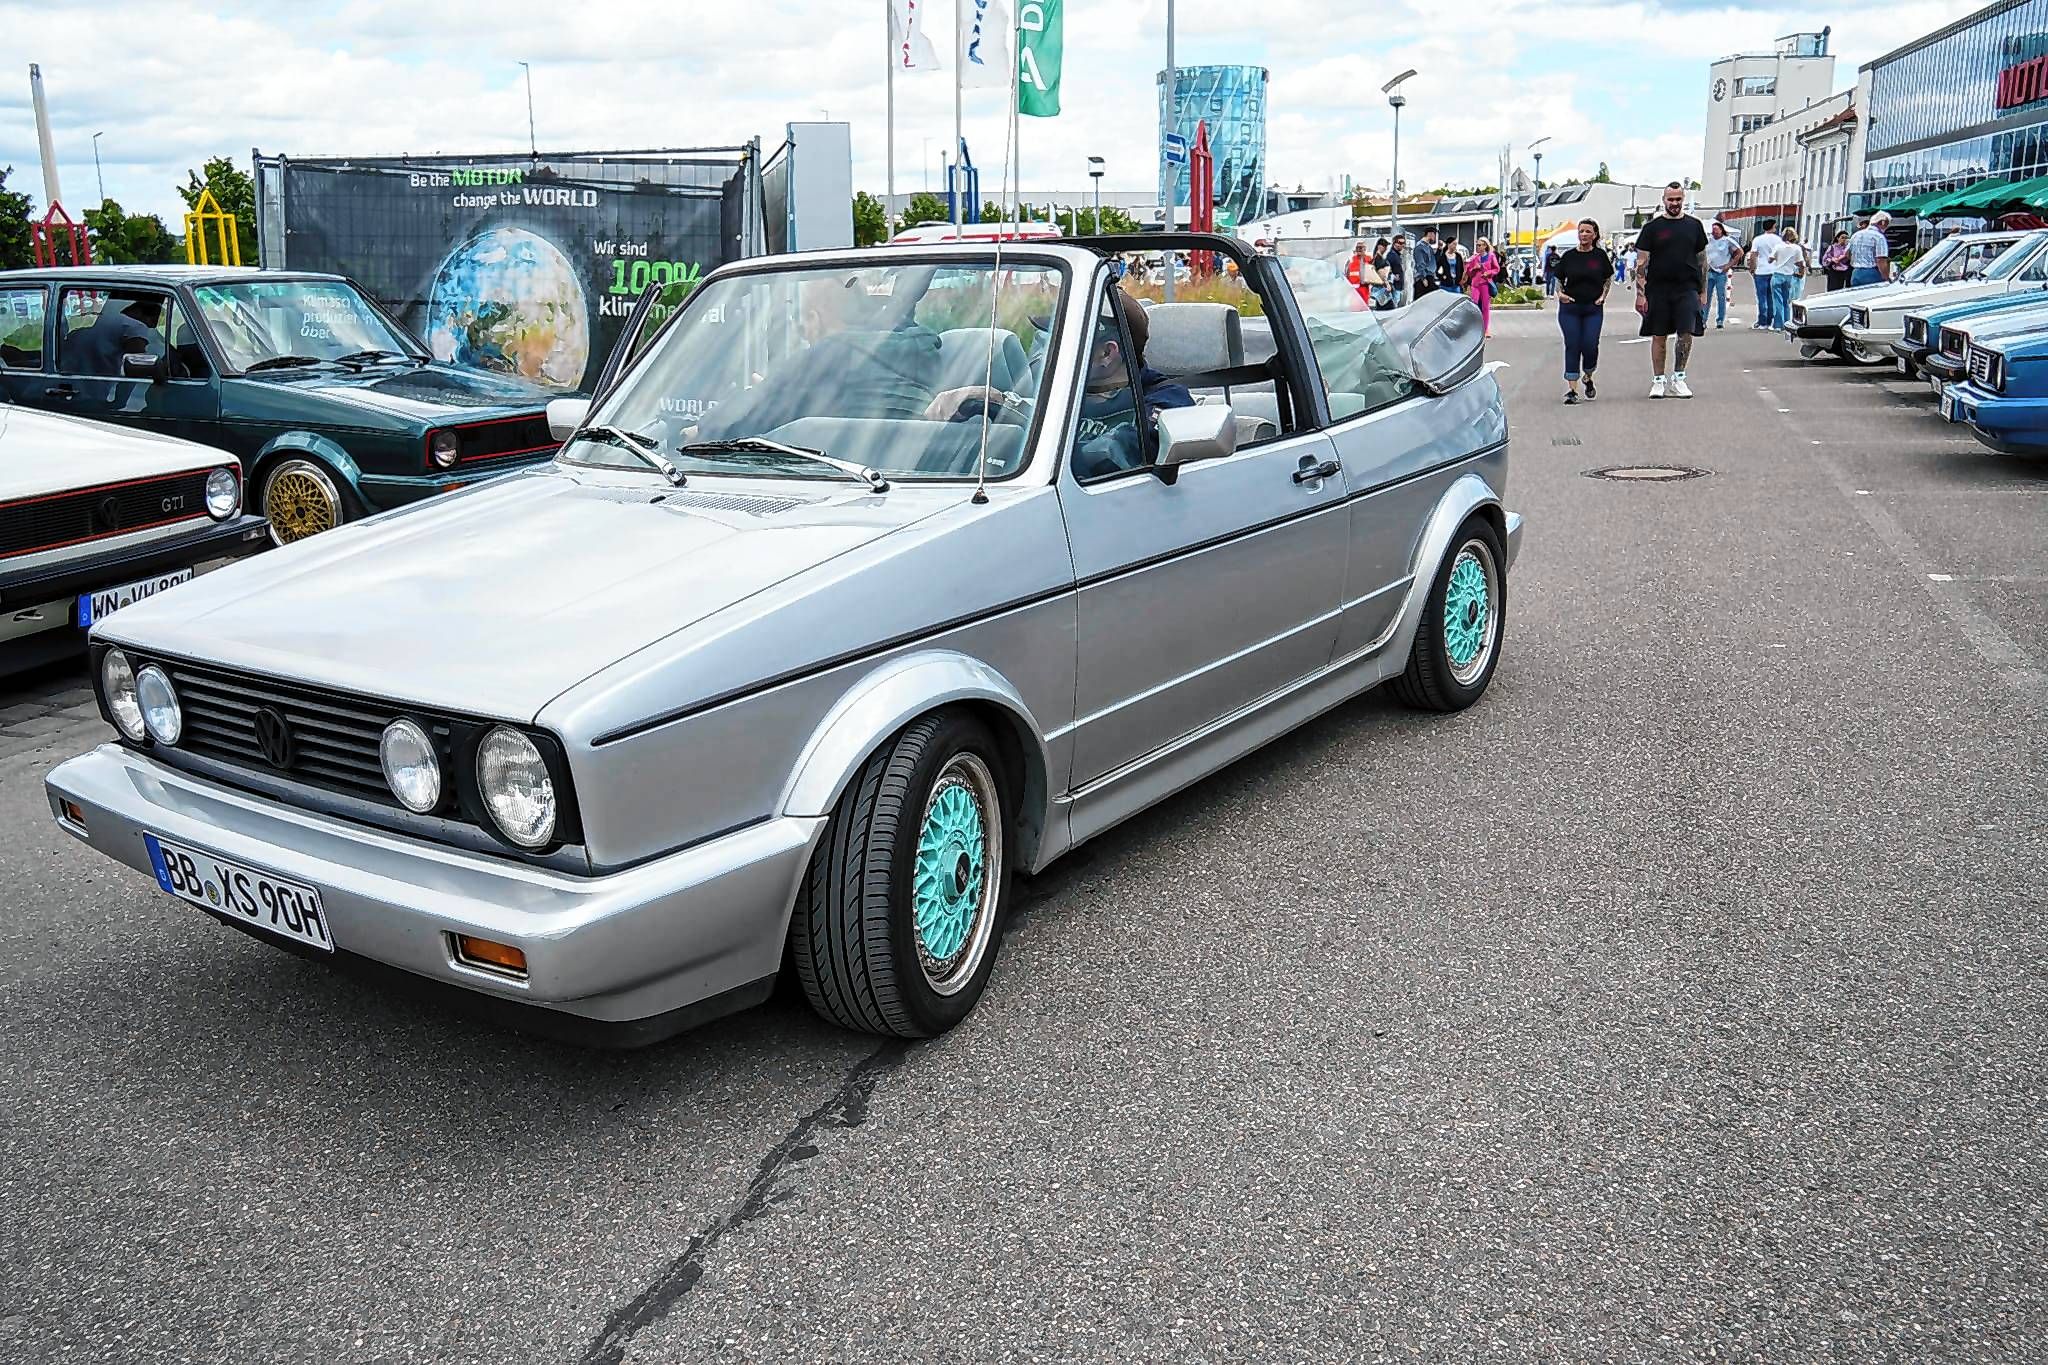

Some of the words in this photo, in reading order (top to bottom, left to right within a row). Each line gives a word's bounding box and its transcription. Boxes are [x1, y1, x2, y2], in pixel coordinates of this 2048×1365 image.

[410, 173, 427, 187] Be
[430, 173, 449, 187] the
[453, 193, 497, 209] change
[500, 191, 521, 205] the
[523, 188, 598, 207] WORLD
[593, 240, 615, 255] Wir
[619, 241, 648, 256] sind
[161, 495, 185, 513] GTI
[92, 591, 119, 620] WN
[160, 847, 204, 898] BB
[213, 864, 259, 917] XS
[258, 880, 327, 942] 90H
